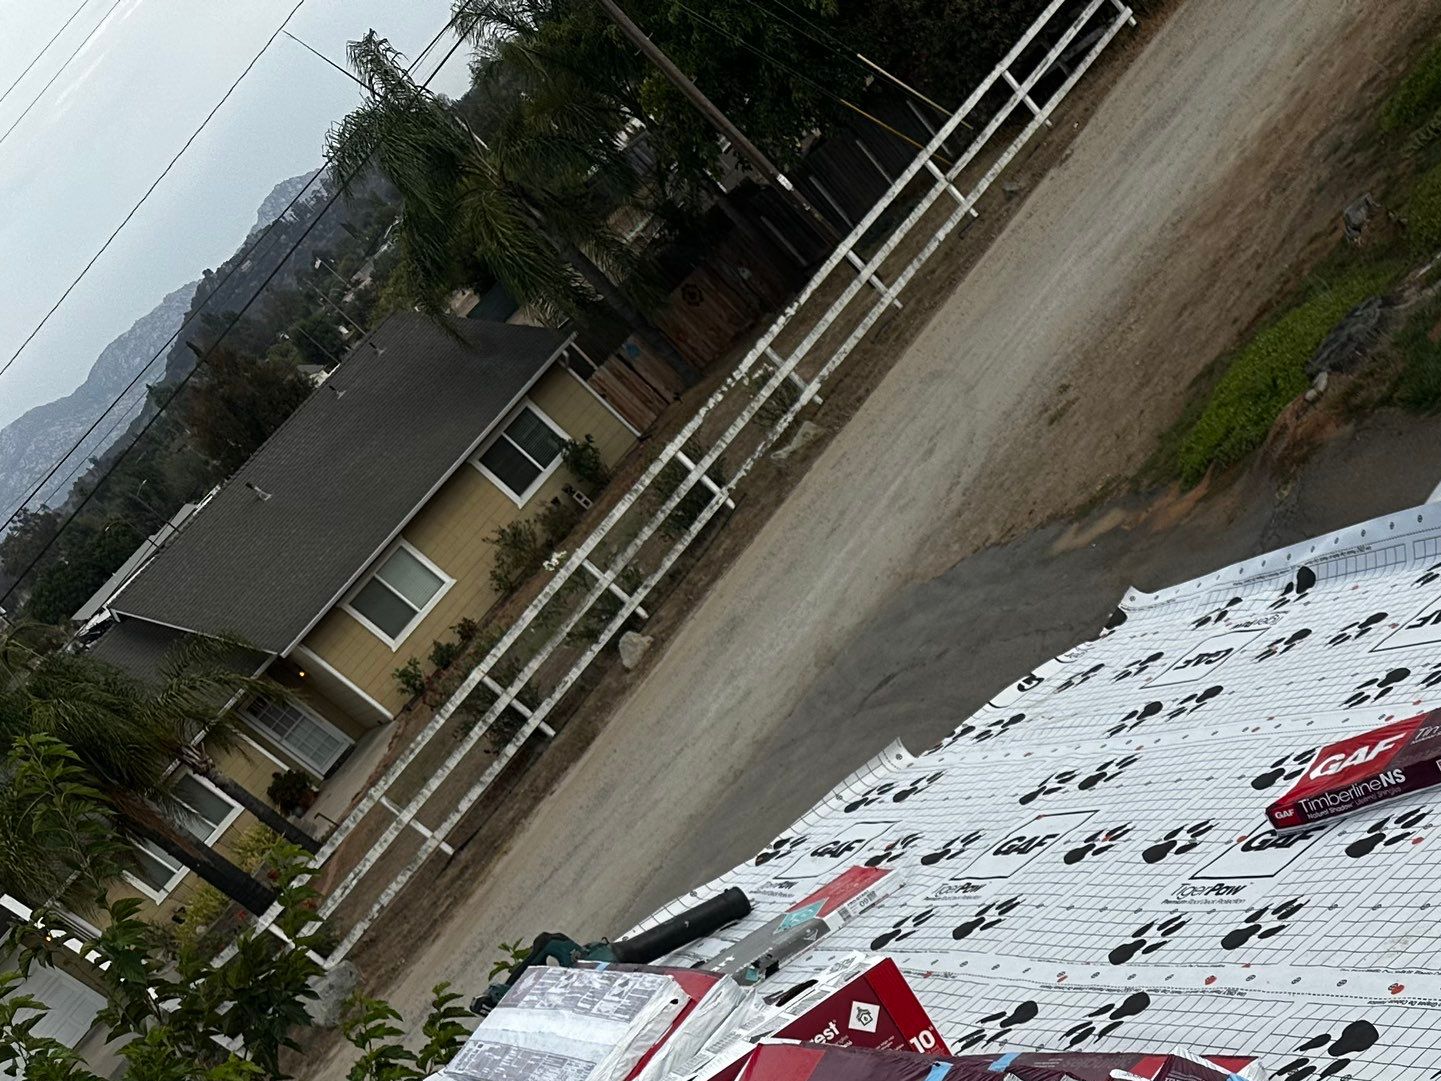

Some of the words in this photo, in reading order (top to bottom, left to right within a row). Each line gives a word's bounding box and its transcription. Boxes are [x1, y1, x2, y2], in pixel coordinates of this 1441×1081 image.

[1309, 731, 1409, 781] GAF
[1274, 807, 1295, 820] GAF
[1297, 768, 1406, 814] TimberlineNS
[810, 838, 866, 859] GAF
[993, 833, 1060, 857] GAF
[1172, 881, 1247, 900] TigerPaw
